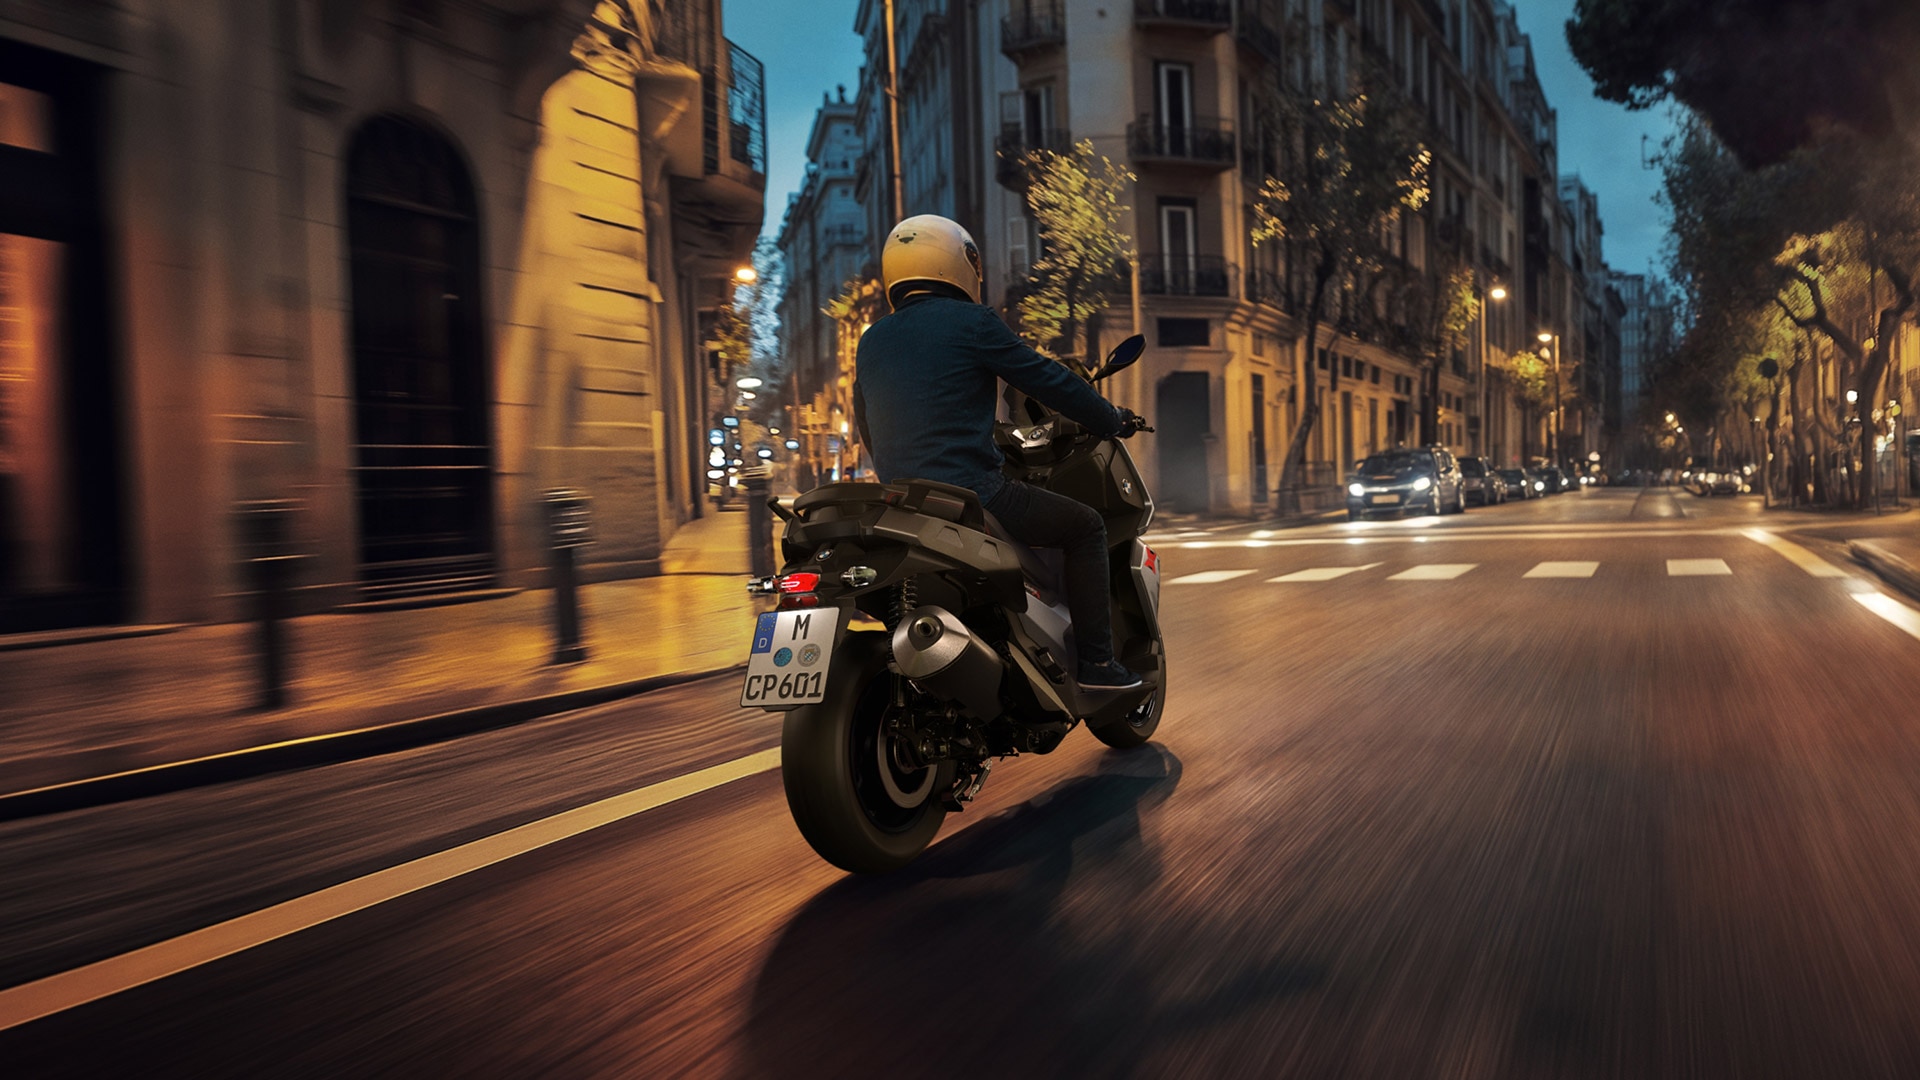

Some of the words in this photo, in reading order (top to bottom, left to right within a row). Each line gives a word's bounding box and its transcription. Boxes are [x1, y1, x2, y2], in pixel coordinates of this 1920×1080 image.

[792, 614, 811, 640] M
[758, 637, 768, 649] D
[745, 672, 822, 700] CP601
